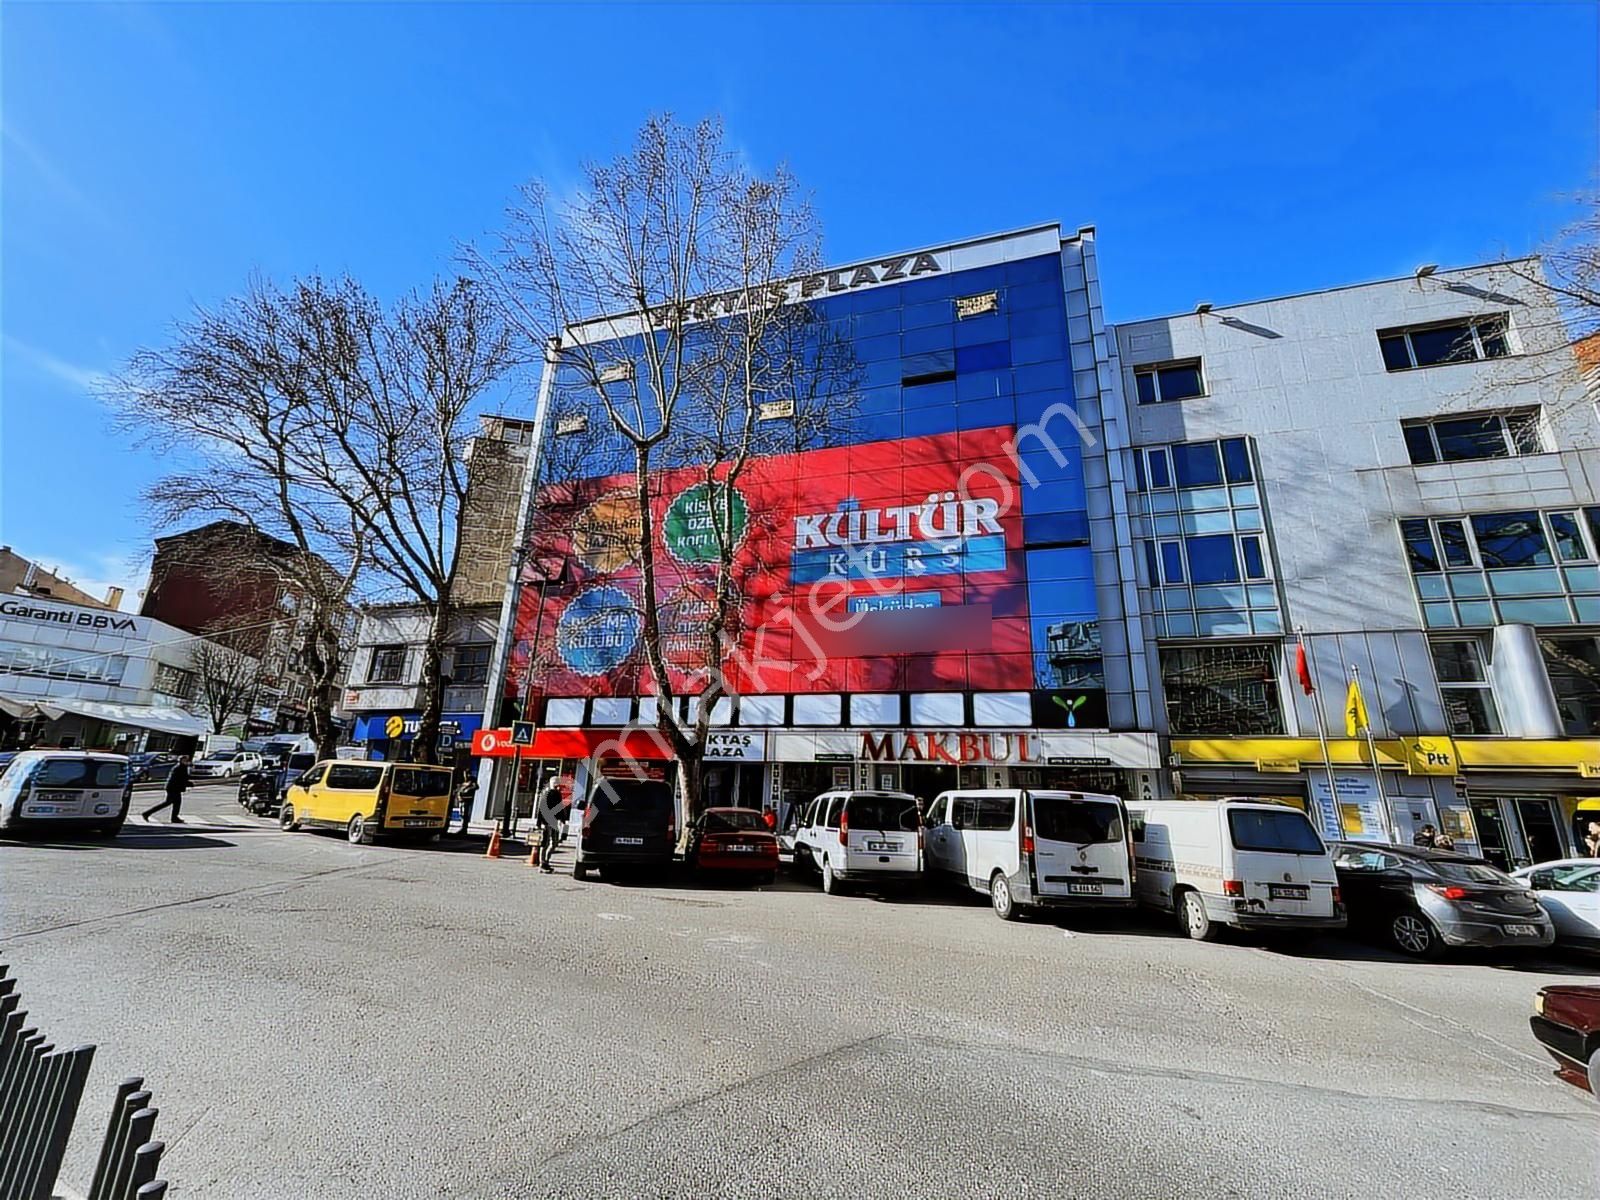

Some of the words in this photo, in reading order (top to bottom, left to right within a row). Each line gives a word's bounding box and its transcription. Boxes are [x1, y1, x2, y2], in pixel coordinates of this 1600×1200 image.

[801, 253, 941, 298] PLAZA
[792, 491, 1005, 549] KÜLTÜR
[828, 544, 960, 576] KURS
[0, 601, 72, 624] Garanti
[76, 612, 137, 632] BBVA
[707, 734, 752, 748] KTAŞ
[858, 730, 1042, 765] MAKBUL
[1427, 753, 1450, 766] Ptt
